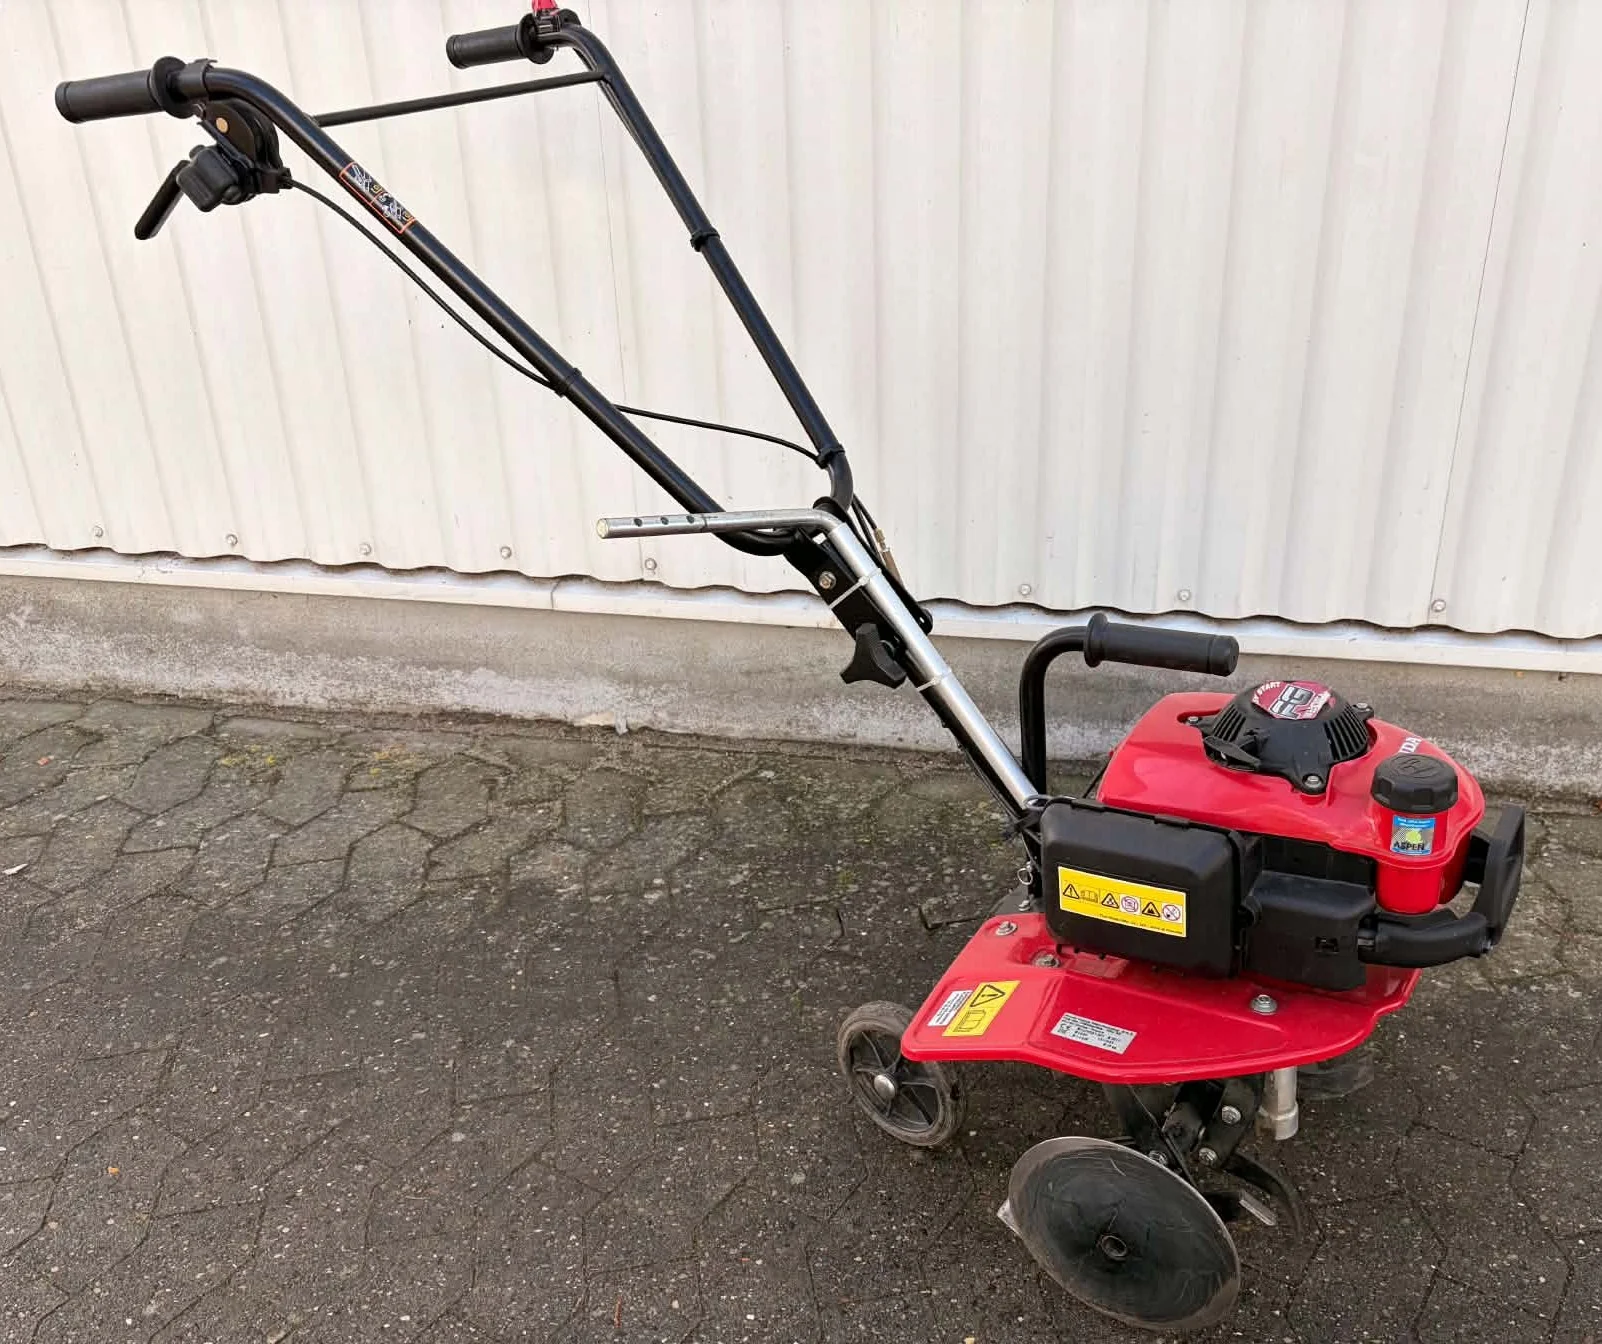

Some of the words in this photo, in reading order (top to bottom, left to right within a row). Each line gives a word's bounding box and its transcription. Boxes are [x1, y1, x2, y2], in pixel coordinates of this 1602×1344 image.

[1256, 681, 1281, 695] START
[1269, 684, 1315, 720] FG
[1393, 841, 1425, 851] ASPEN
